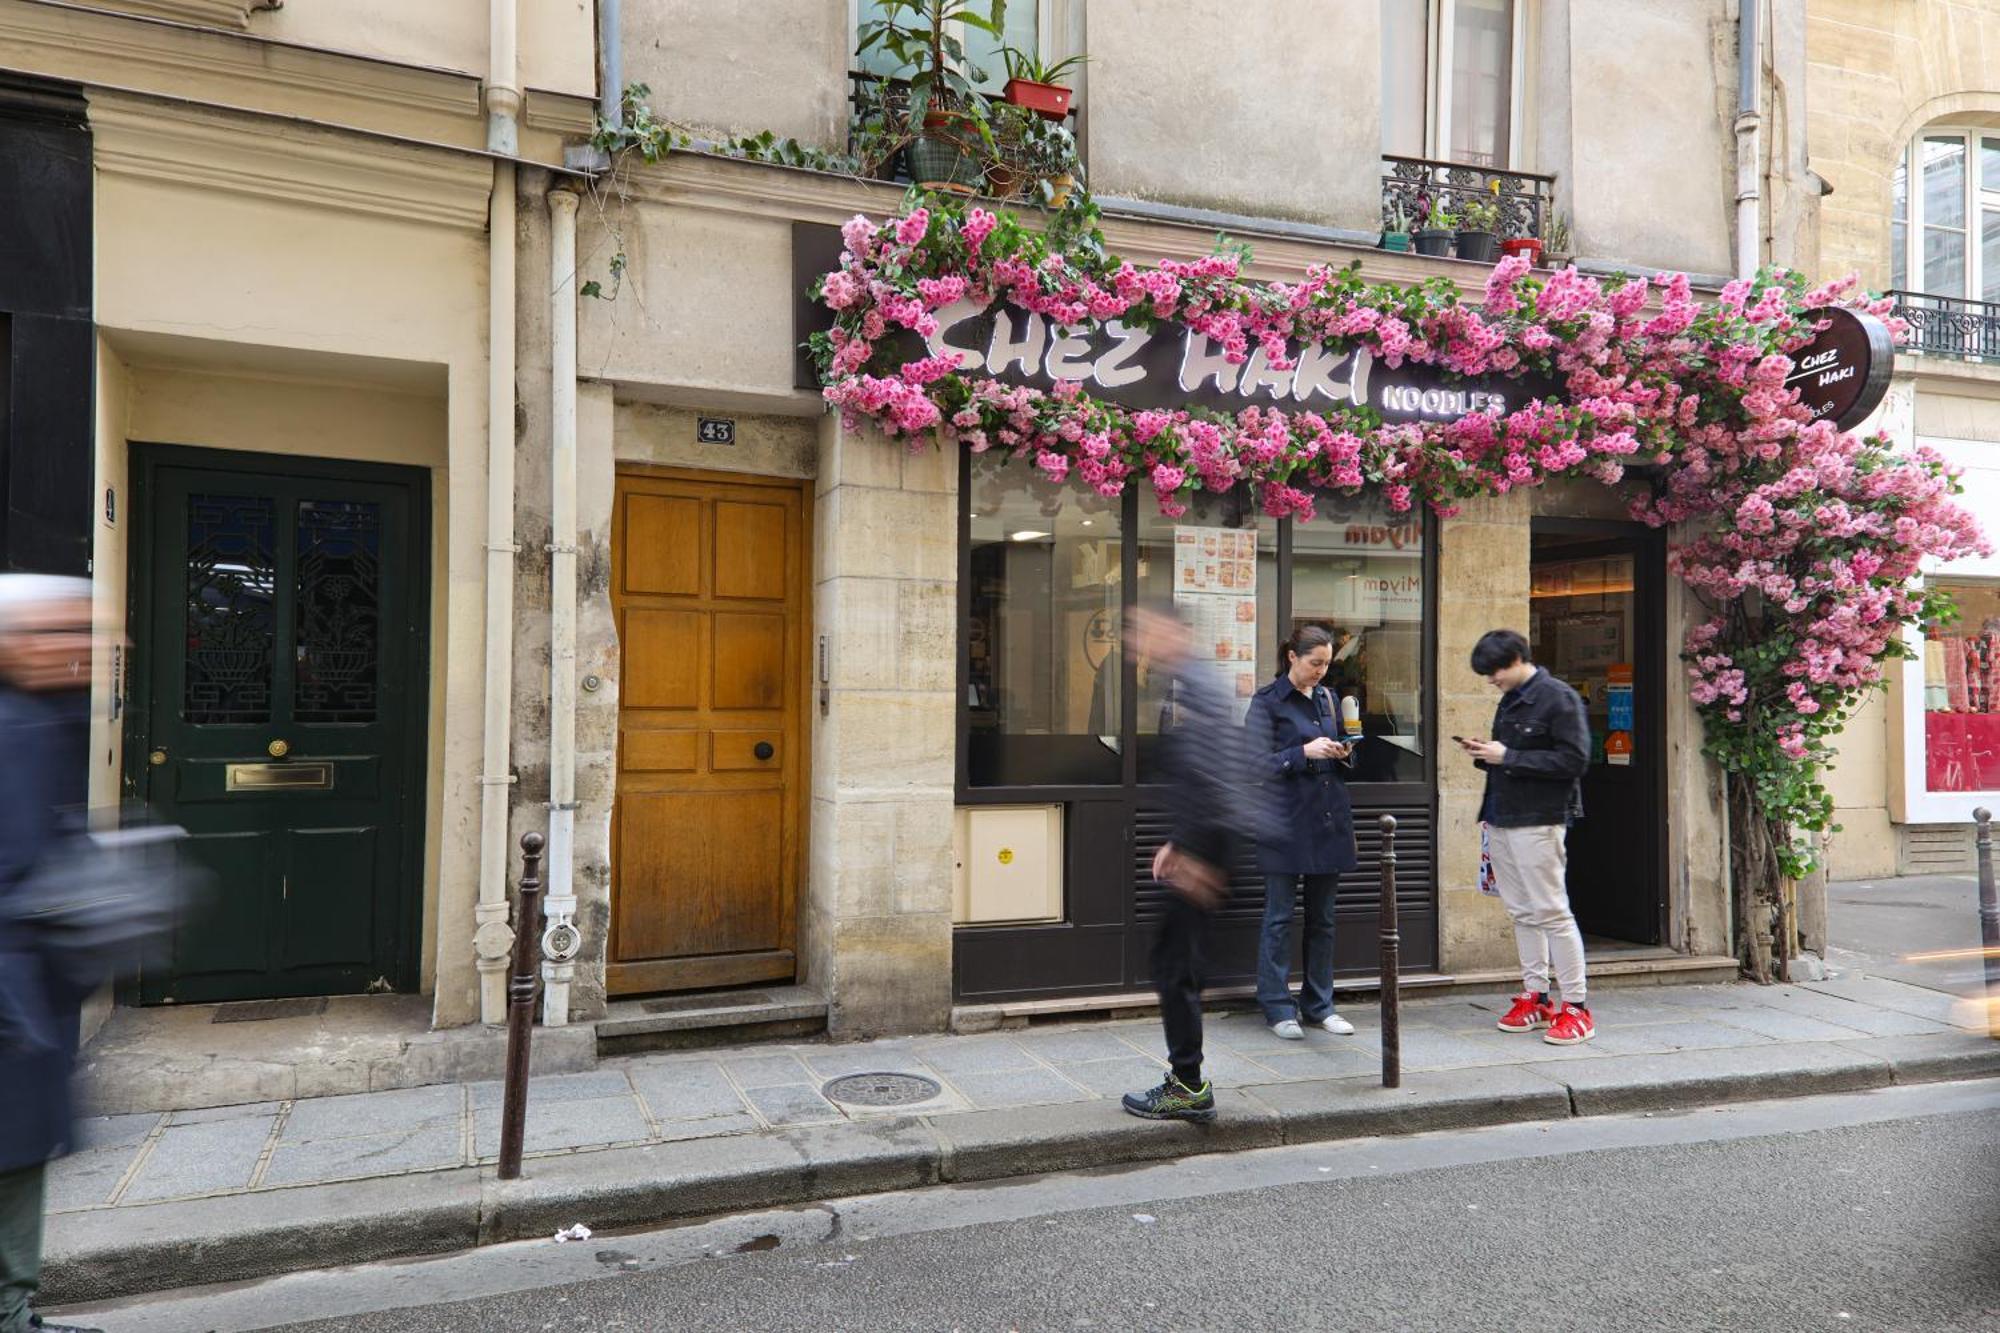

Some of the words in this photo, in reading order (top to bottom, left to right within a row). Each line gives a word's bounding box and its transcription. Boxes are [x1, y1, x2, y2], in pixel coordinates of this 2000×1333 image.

[924, 300, 1151, 387] CHEZ
[1179, 327, 1373, 406] HAKI
[1801, 349, 1838, 369] CHEZ
[1819, 366, 1854, 387] HAKI
[1382, 385, 1506, 416] NOODLES
[1811, 400, 1835, 418] DLES
[703, 422, 729, 440] 43
